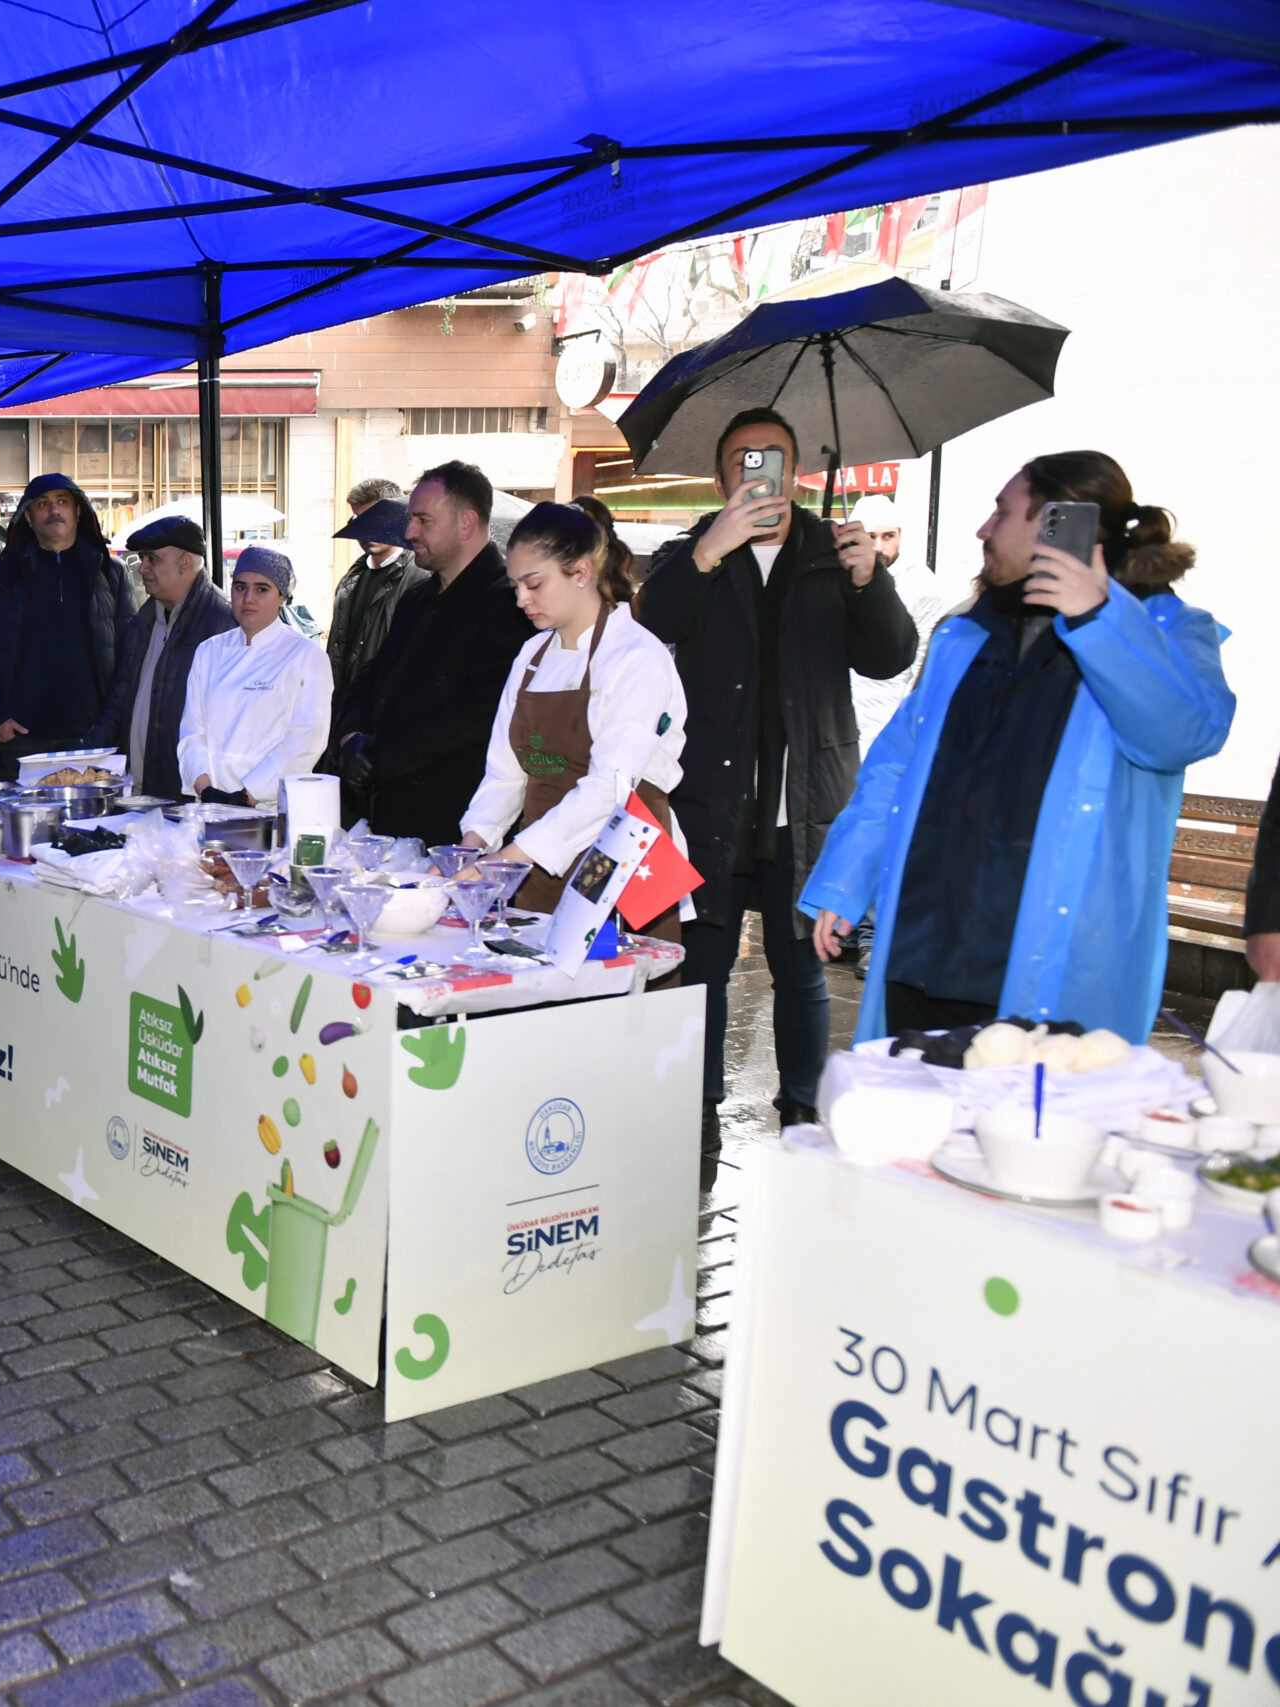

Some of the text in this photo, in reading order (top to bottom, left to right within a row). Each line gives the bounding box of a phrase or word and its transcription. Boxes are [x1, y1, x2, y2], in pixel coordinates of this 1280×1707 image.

[139, 1008, 173, 1034] Atıksız
[138, 1024, 183, 1058] Üsküdar
[138, 1047, 177, 1076] Atıksız
[137, 1065, 178, 1097] Mutfak
[833, 1326, 908, 1396] 30
[926, 1365, 1079, 1479] Mart
[1097, 1445, 1240, 1548] Sıfır
[829, 1399, 1280, 1692] Gastron
